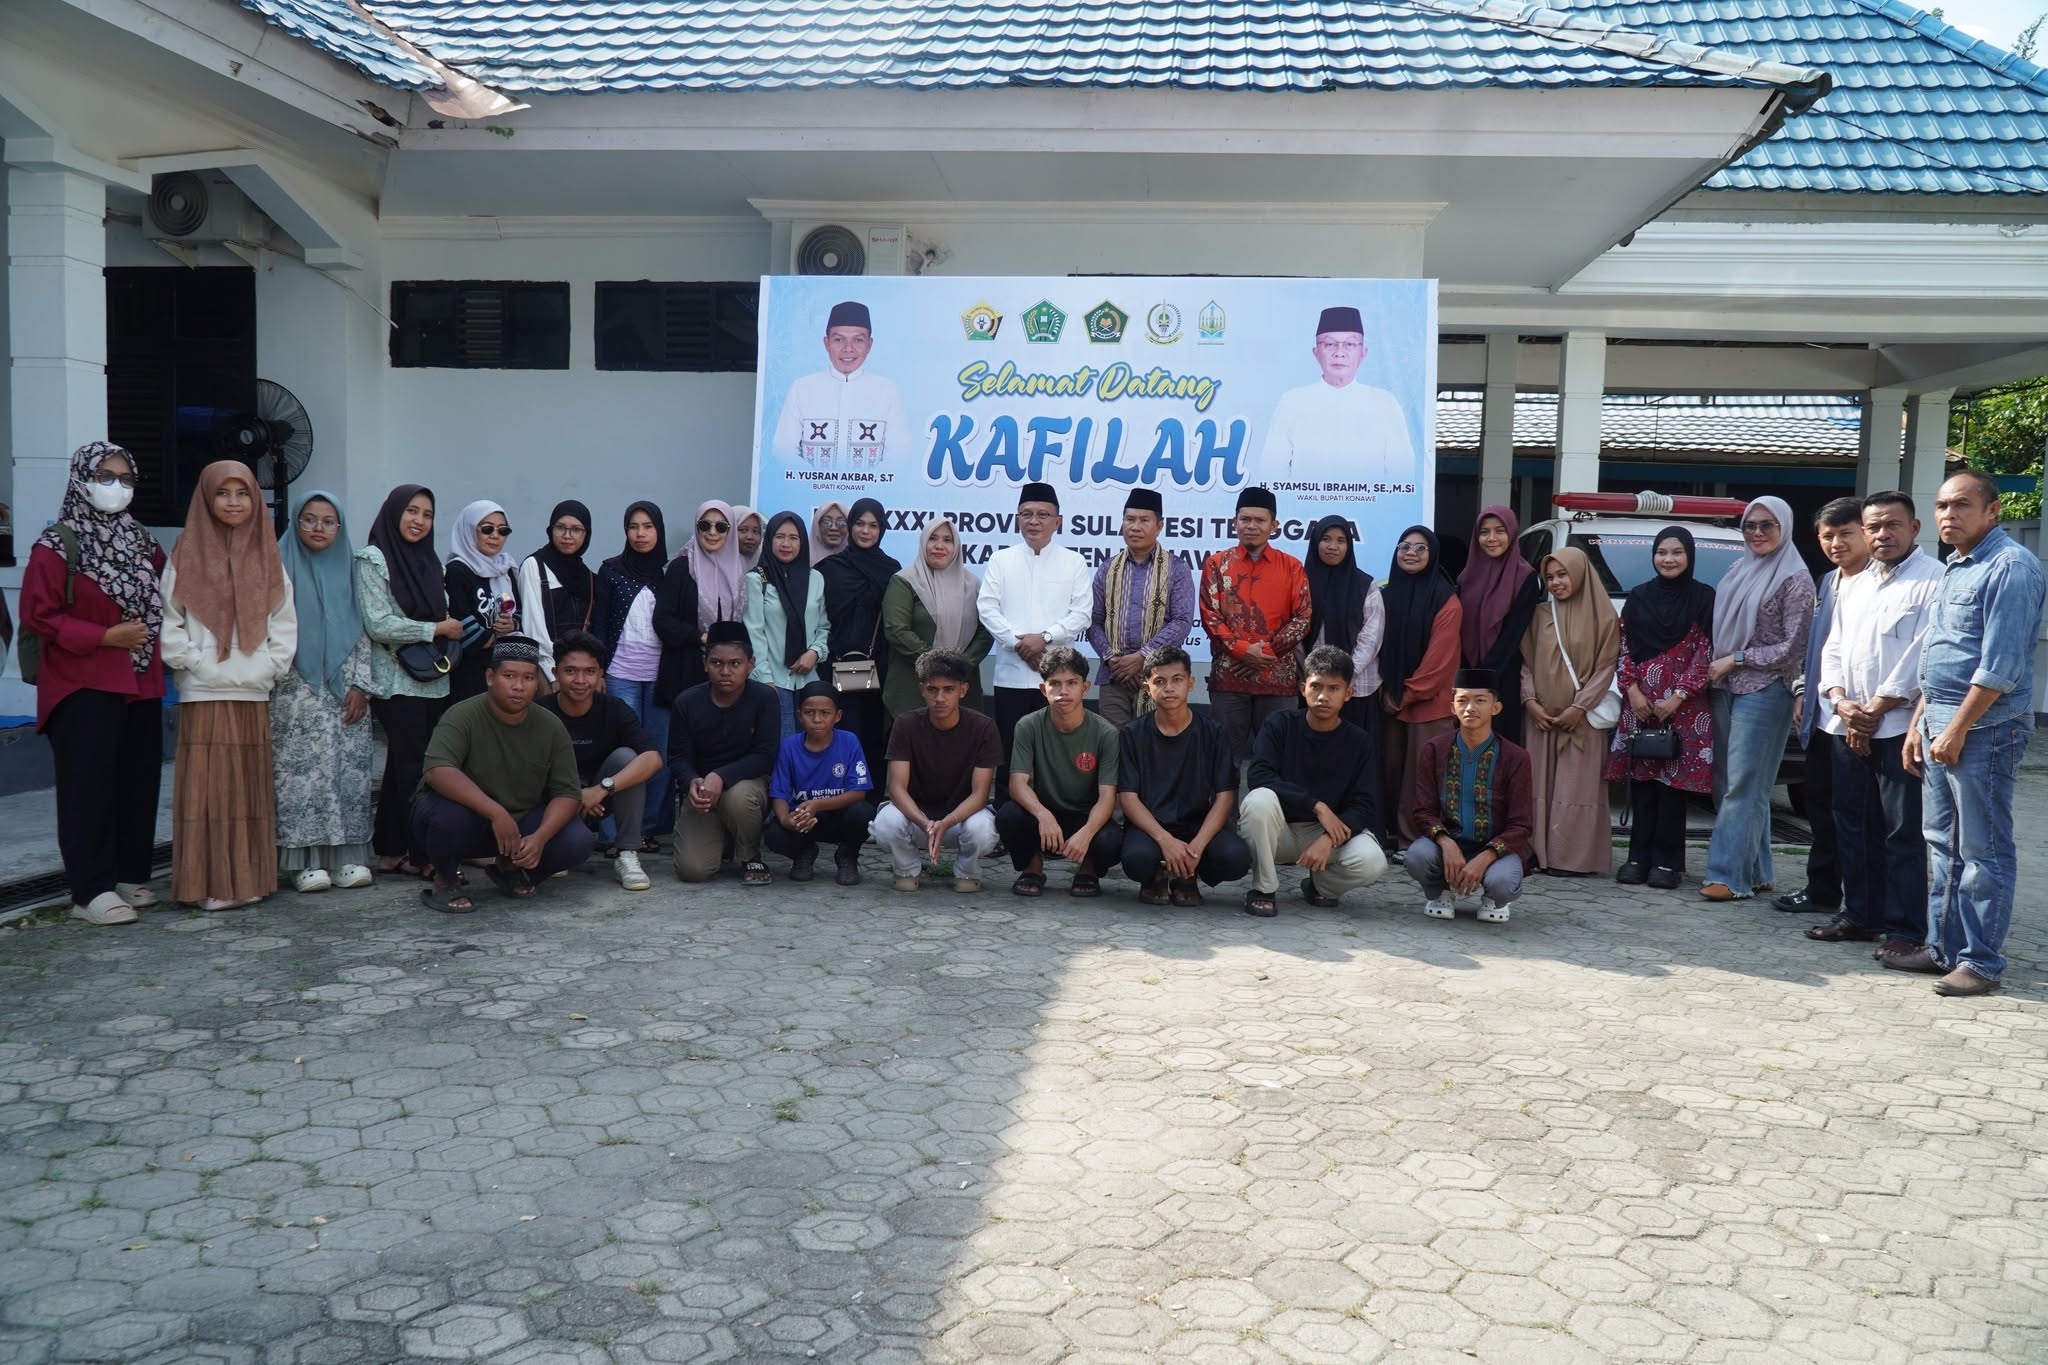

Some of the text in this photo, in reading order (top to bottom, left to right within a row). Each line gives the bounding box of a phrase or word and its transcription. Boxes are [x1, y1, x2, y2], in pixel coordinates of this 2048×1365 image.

[957, 360, 1222, 413] Selamat Datang
[926, 414, 1248, 488] KAFILAH
[785, 471, 895, 483] H. YUSRAN AKBAR, S.T
[1259, 482, 1270, 491] H.
[1272, 482, 1321, 491] SYAMSUL
[1323, 483, 1371, 493] IBRAHIM,
[1070, 514, 1201, 539] SULESI
